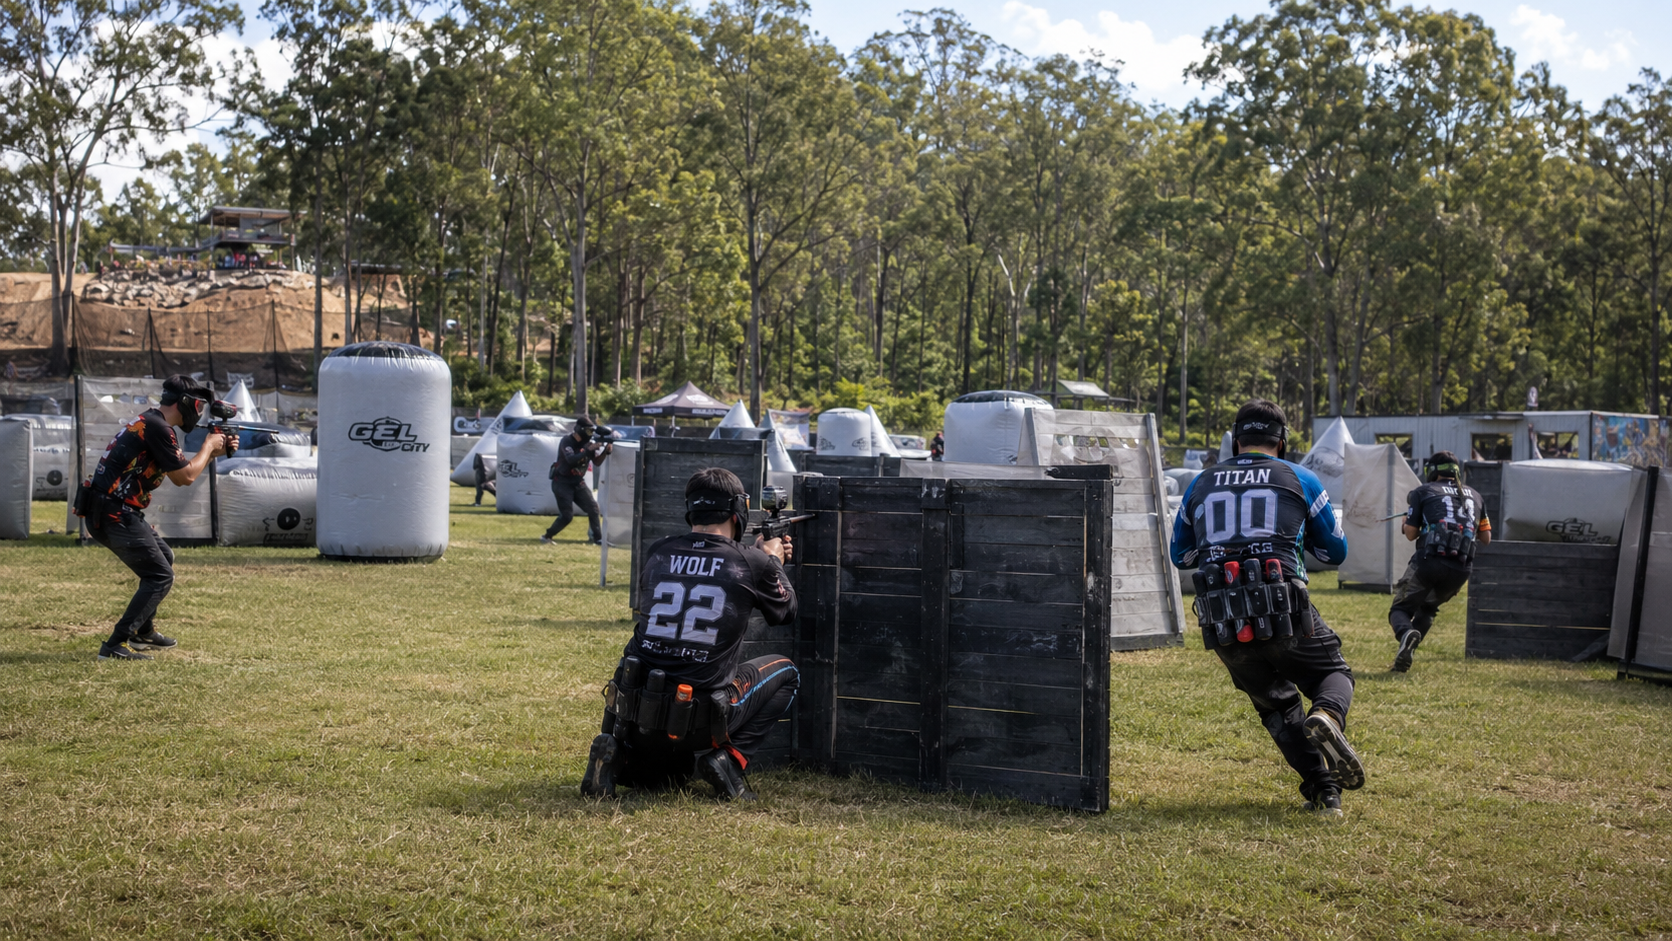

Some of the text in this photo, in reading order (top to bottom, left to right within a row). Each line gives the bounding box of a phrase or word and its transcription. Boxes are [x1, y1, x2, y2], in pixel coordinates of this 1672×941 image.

[348, 423, 418, 442] GEL
[401, 443, 430, 452] CITY
[1213, 469, 1271, 486] TITAN
[1204, 489, 1277, 544] 00
[1546, 520, 1598, 537] GEL
[669, 555, 724, 577] WOLF
[645, 581, 727, 646] 22
